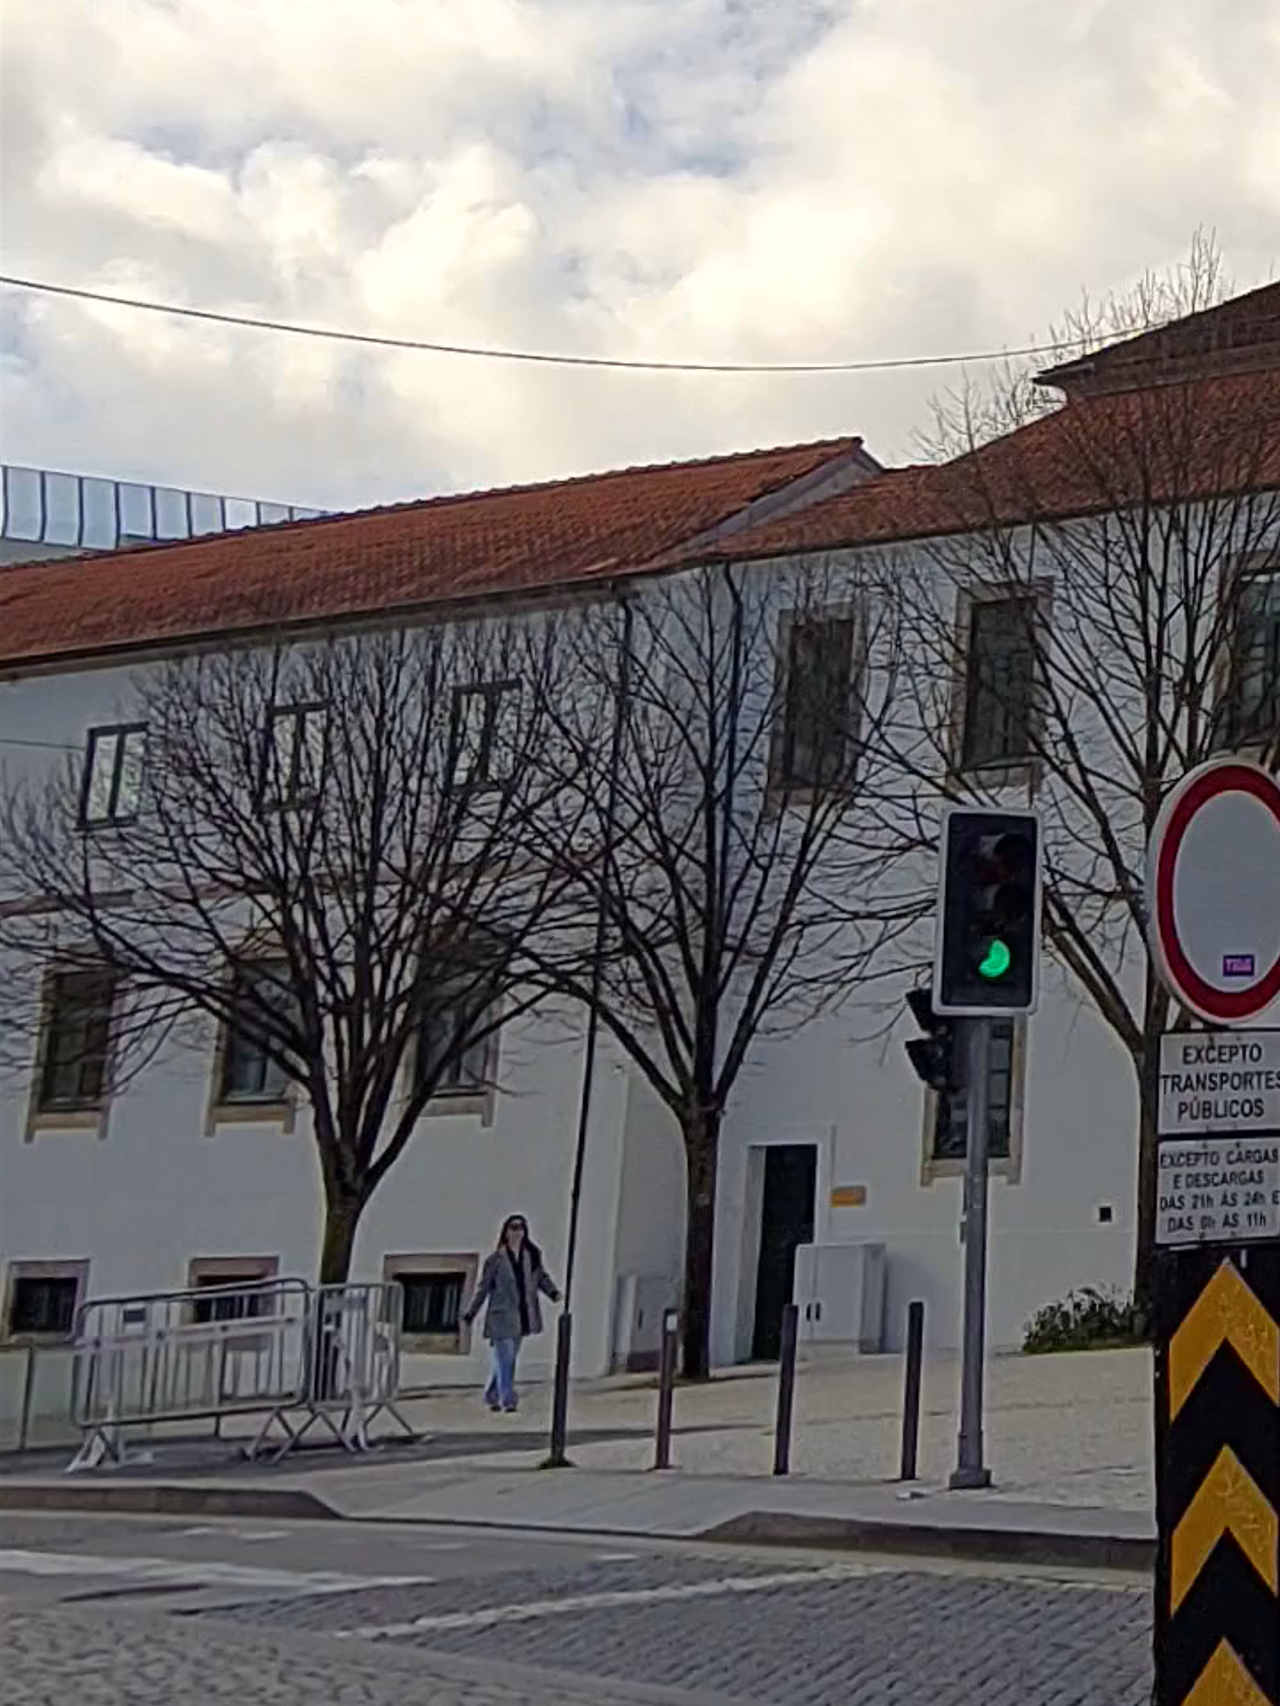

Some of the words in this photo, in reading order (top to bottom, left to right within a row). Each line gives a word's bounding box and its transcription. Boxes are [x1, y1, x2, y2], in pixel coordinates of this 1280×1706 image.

[1182, 1043, 1263, 1065] EXCEPTO
[1178, 1095, 1265, 1122] PÚBLICOS
[1160, 1150, 1220, 1169] EXCEPTO
[1226, 1148, 1279, 1165] CARGAS
[1173, 1173, 1183, 1189] E
[1185, 1169, 1264, 1188] DESCARGAS
[1160, 1194, 1185, 1211] DAS
[1271, 1189, 1280, 1205] E
[1167, 1215, 1195, 1233] DAS
